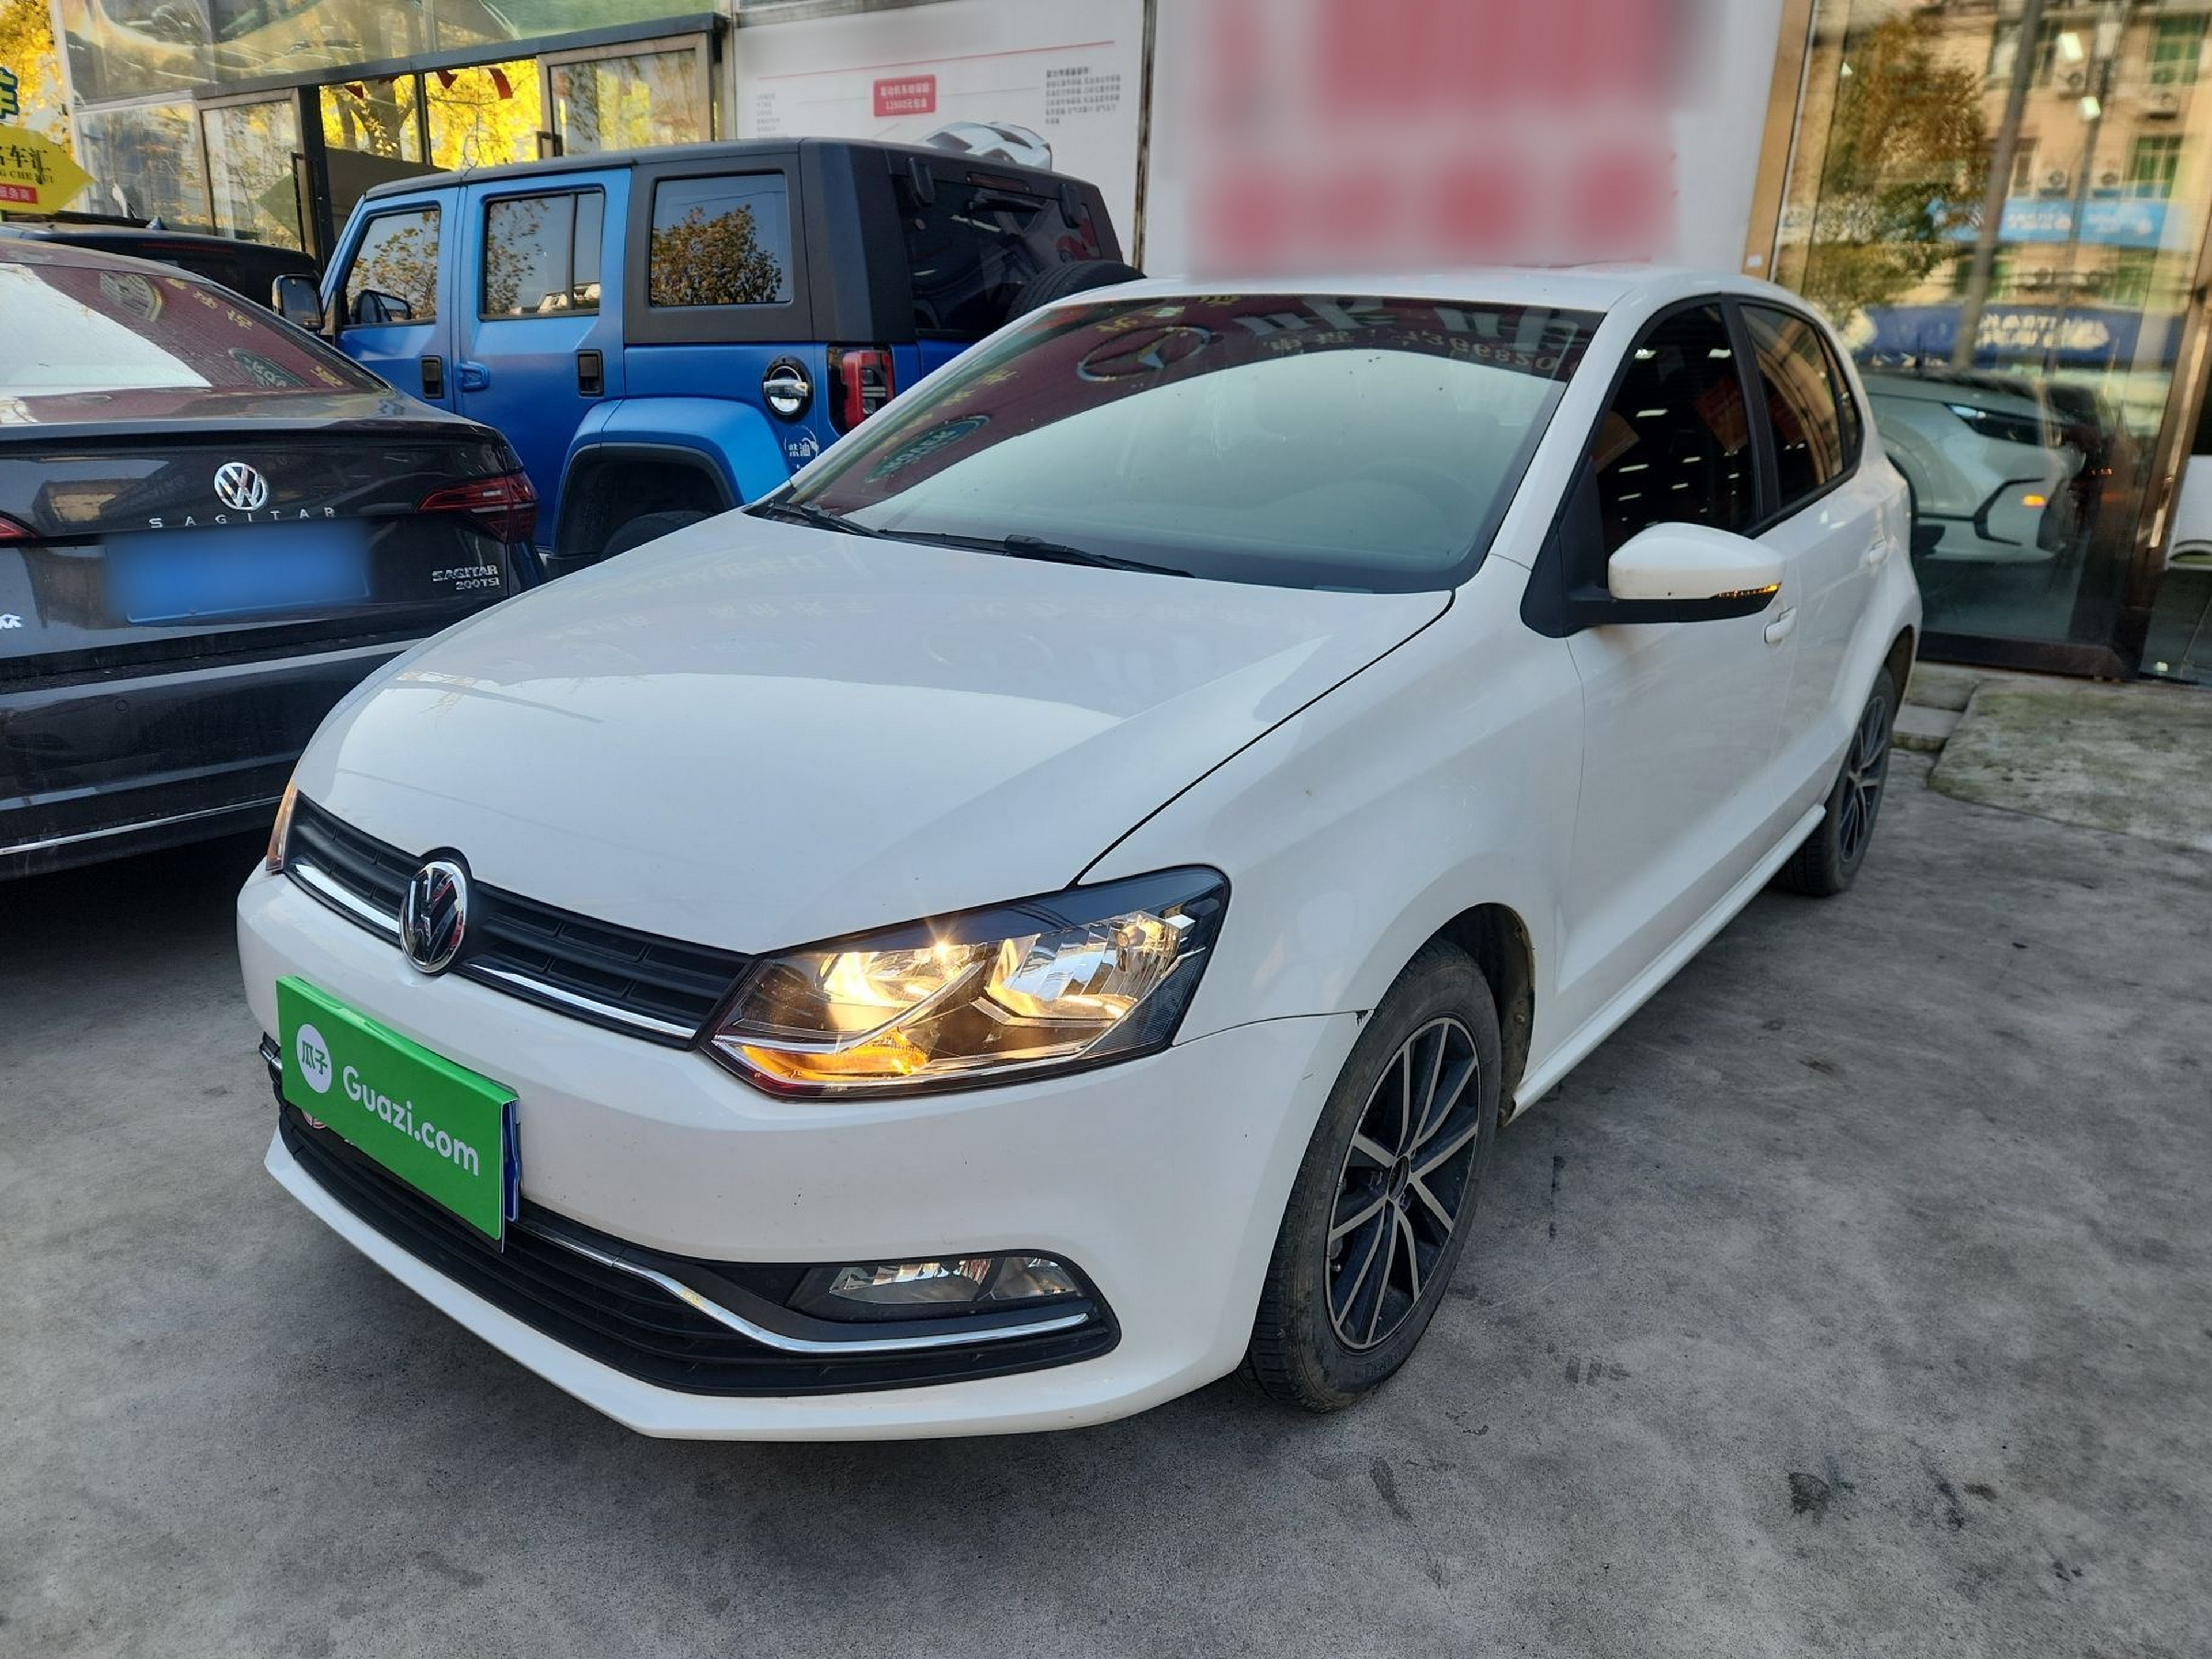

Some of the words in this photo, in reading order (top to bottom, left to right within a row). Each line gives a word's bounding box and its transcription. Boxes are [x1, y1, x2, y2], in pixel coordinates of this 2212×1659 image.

[149, 507, 336, 528] SAGITAR
[431, 565, 498, 582] SAGITAR
[455, 577, 500, 590] 200TSI
[301, 1040, 328, 1075] 瓜子
[343, 1066, 479, 1176] Guazi.com
